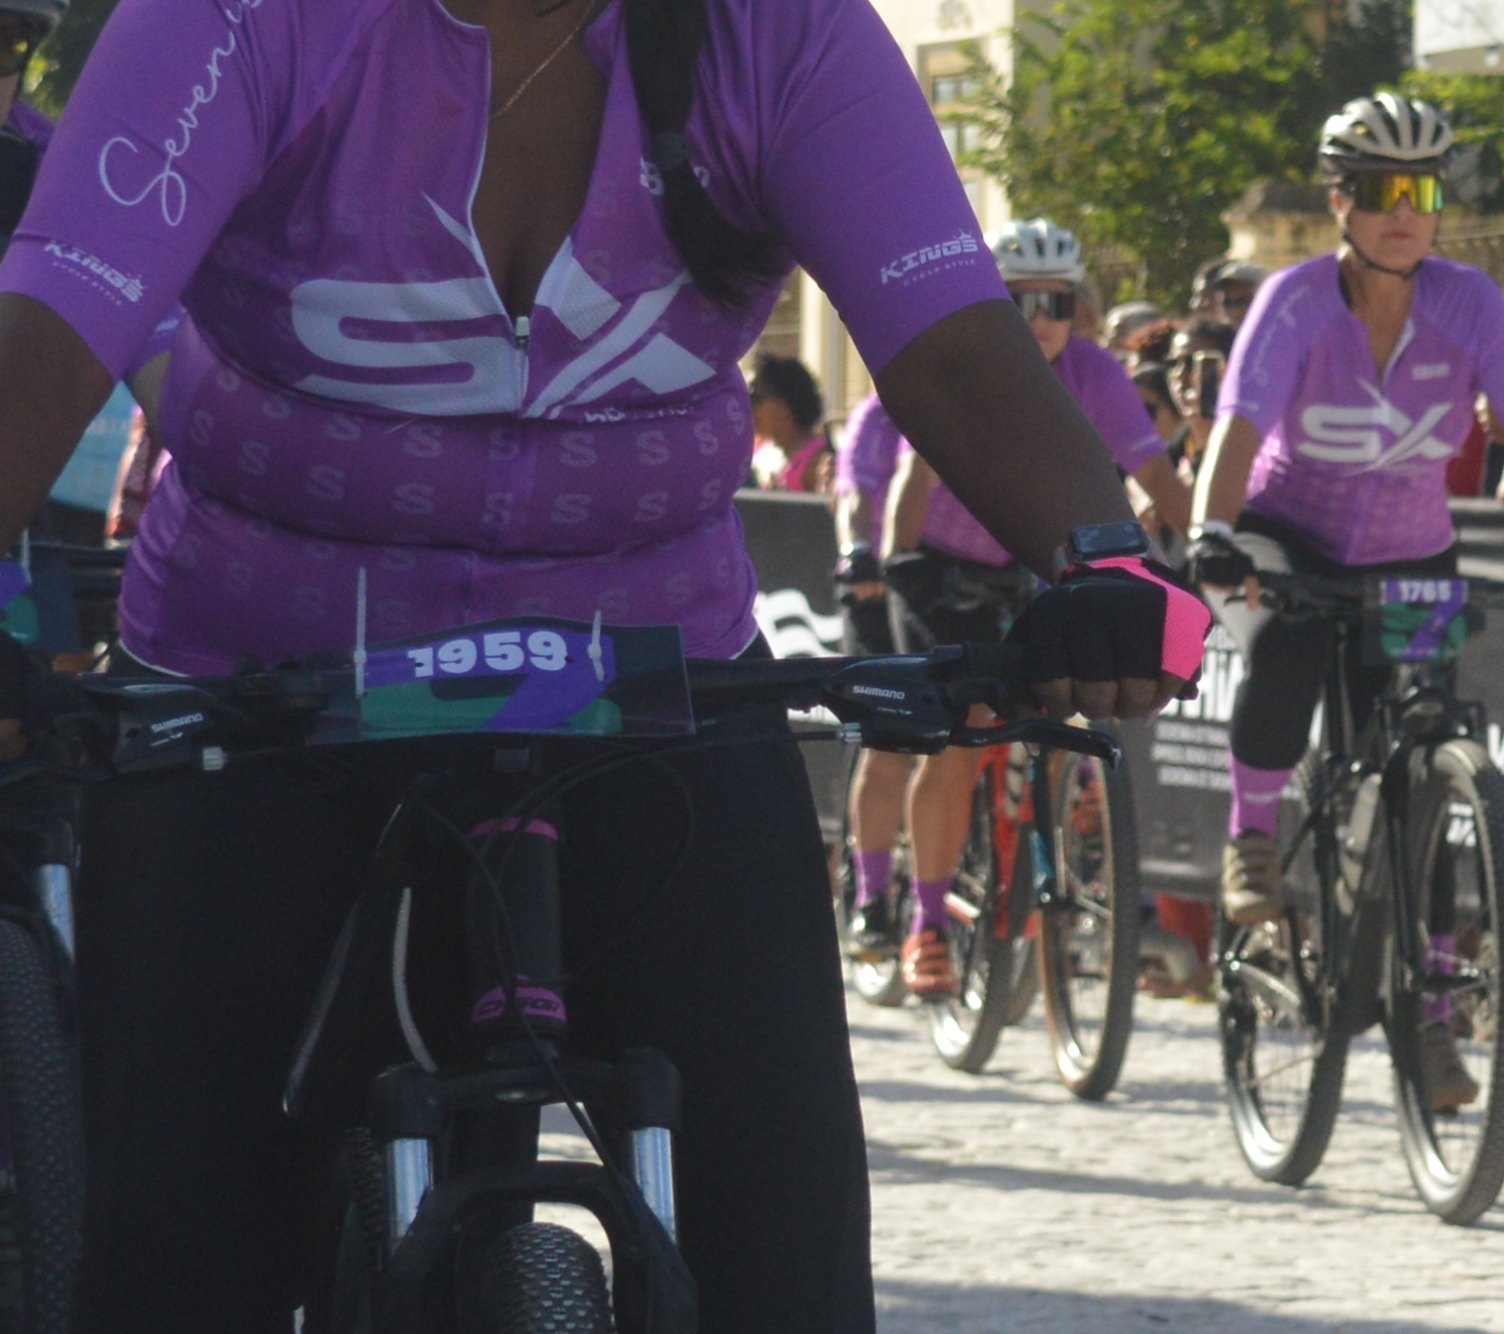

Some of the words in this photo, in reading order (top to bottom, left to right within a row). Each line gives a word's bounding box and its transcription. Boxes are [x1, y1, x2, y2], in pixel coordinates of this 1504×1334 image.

[99, 30, 236, 227] Seven
[44, 241, 143, 302] KINGS
[881, 238, 978, 285] KINGS
[407, 630, 568, 677] 1959
[853, 685, 905, 700] SHIMANO
